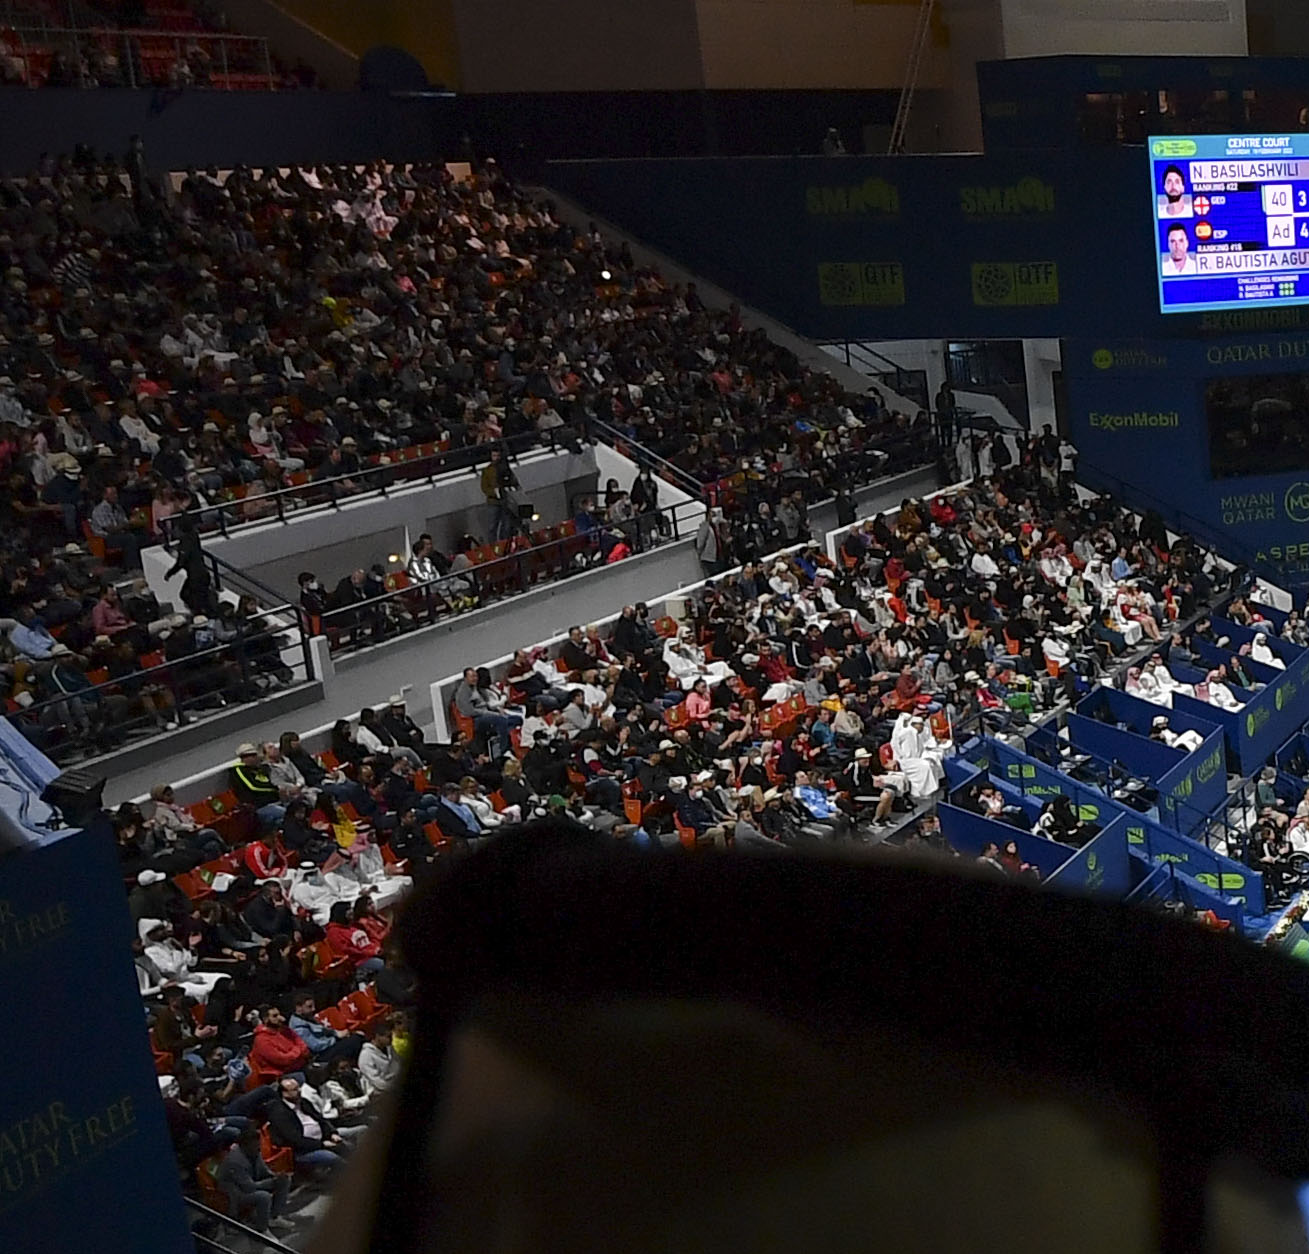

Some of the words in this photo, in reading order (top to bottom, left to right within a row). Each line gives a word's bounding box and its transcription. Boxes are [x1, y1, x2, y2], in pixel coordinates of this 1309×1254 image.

[1227, 137, 1261, 148] CENTRE
[1262, 136, 1291, 147] COURT
[1193, 165, 1207, 179] N.
[1210, 163, 1299, 178] BASILASHVILI
[1271, 191, 1287, 207] 40
[1298, 190, 1307, 207] 3
[1272, 224, 1290, 239] Ad
[1300, 222, 1309, 238] 4
[1200, 256, 1212, 270] R.
[1216, 253, 1277, 269] BAUTISTA
[1016, 263, 1054, 285] QTF
[1207, 343, 1271, 365] QATAR
[1089, 411, 1179, 430] ExxonMobil
[1221, 491, 1275, 510] MWANI
[1223, 507, 1276, 525] QATAR
[0, 1101, 72, 1160] ATAR
[67, 1095, 137, 1157] FREE
